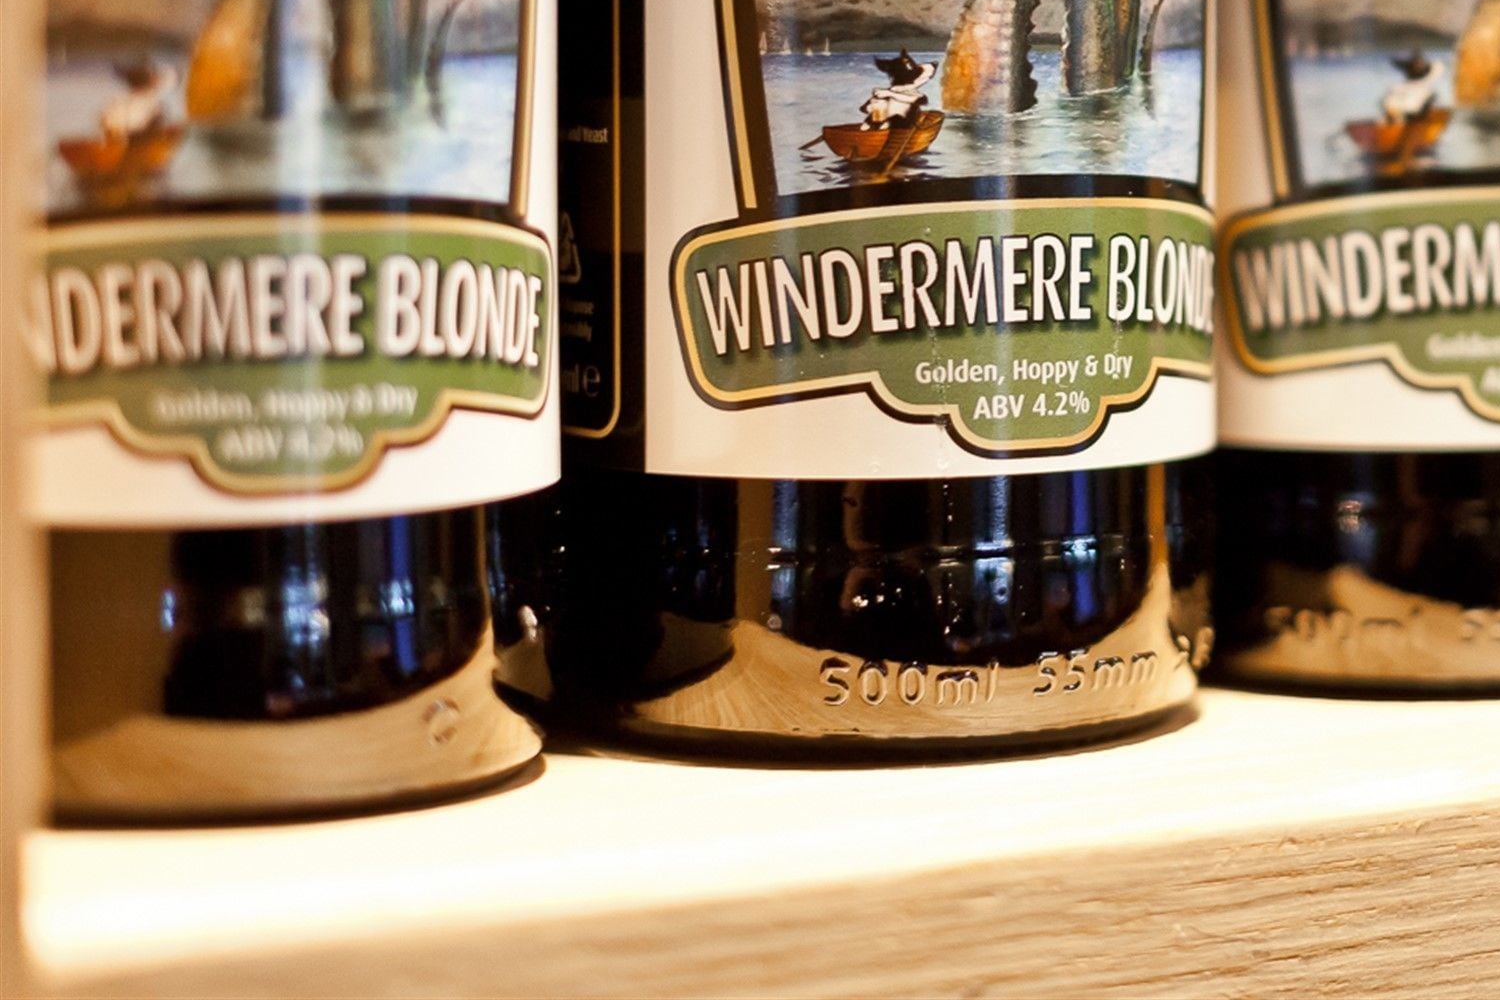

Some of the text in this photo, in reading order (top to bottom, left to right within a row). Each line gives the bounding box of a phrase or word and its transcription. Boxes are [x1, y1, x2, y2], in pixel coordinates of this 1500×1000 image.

[377, 254, 542, 368] BLONDE
[695, 233, 1094, 356] WINDERMERE
[915, 353, 1133, 386] Golden, Hoppy & Dry
[972, 390, 1091, 420] ABV 4.2%
[1032, 648, 1159, 698] 55mm
